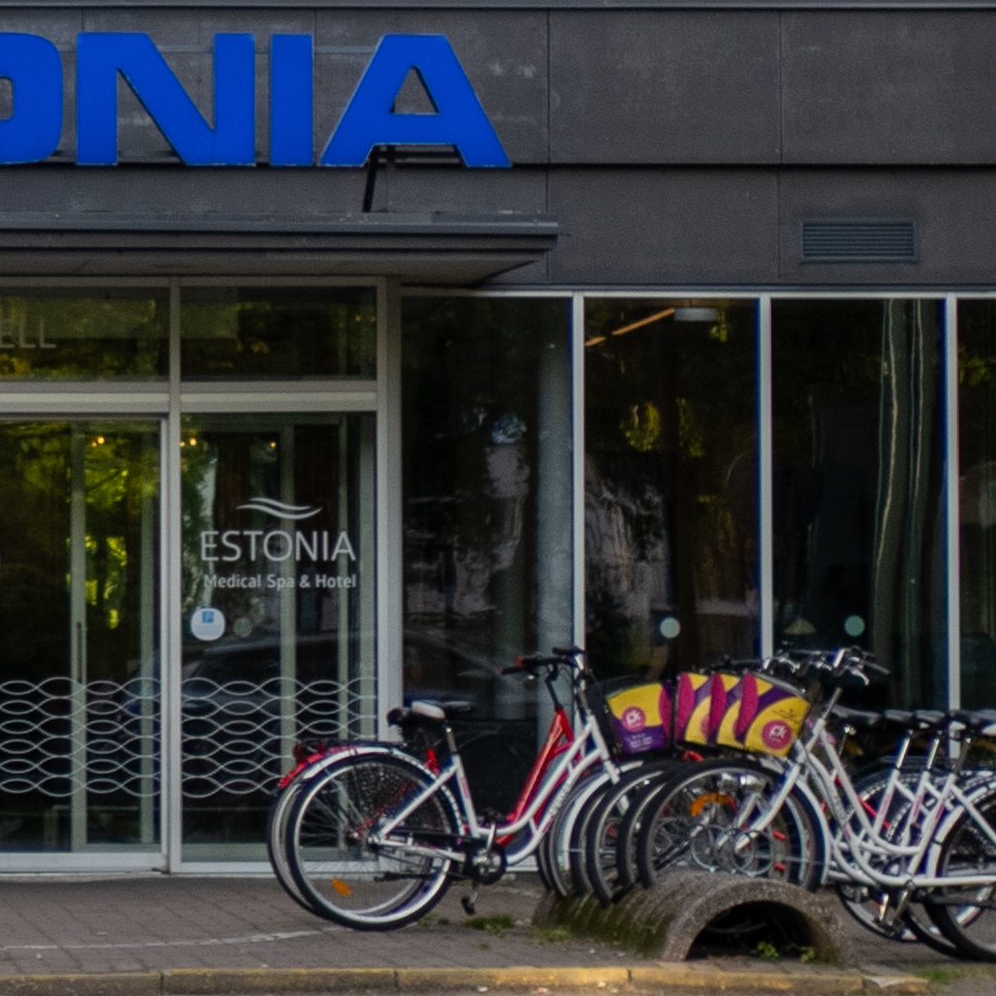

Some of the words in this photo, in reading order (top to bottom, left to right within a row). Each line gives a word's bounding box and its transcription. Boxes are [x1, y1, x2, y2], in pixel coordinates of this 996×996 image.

[200, 530, 357, 562] ESTONIA
[203, 573, 262, 589] Medical
[267, 574, 295, 592] Spa
[299, 574, 311, 589] &
[315, 573, 357, 589] Hotel
